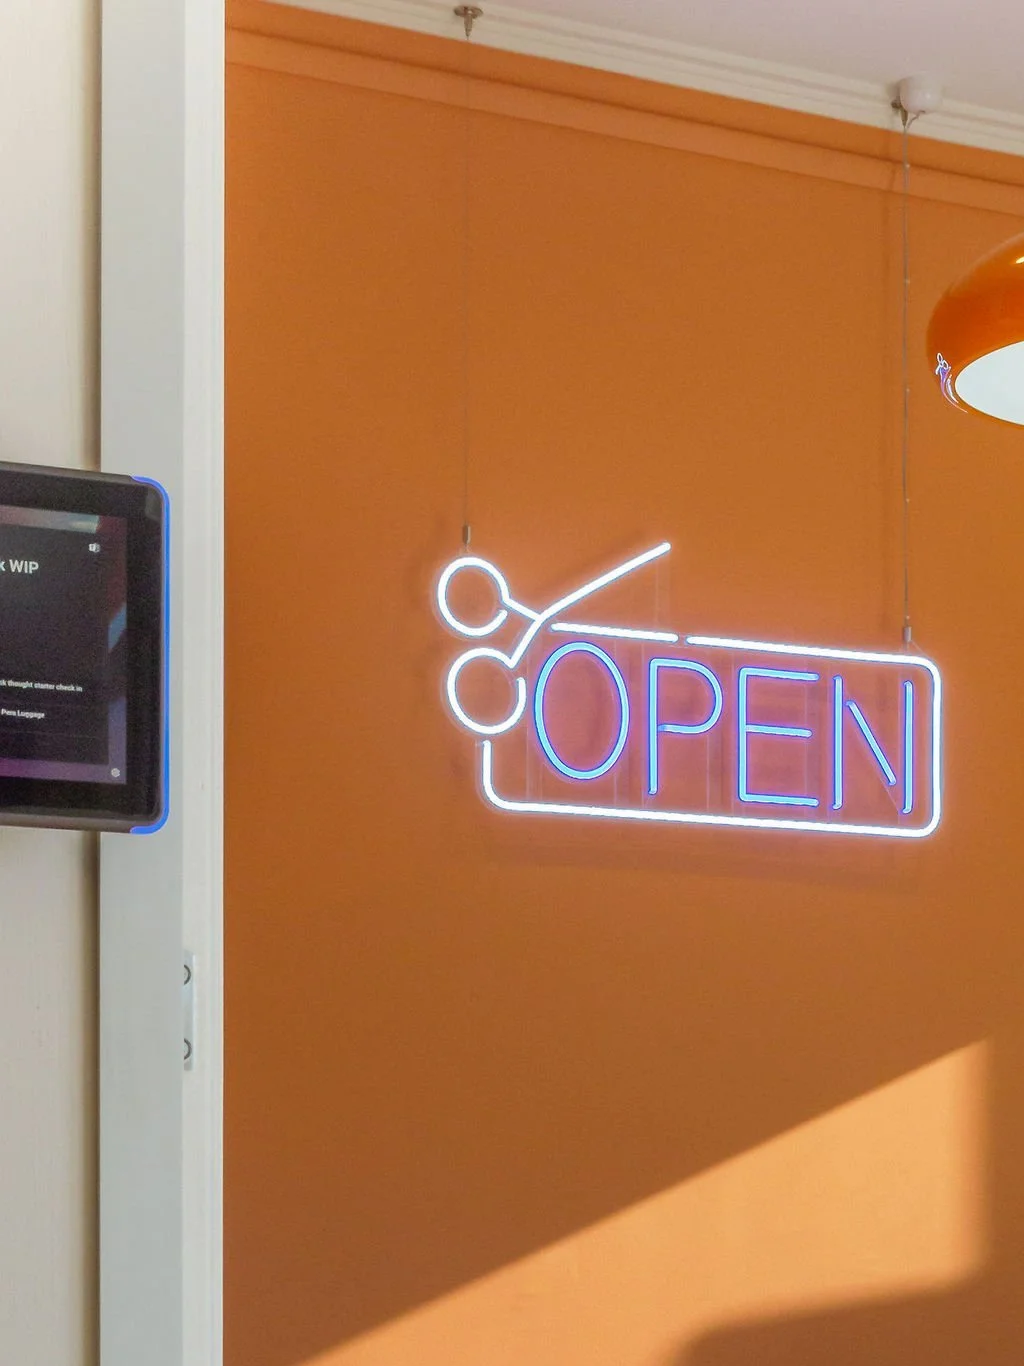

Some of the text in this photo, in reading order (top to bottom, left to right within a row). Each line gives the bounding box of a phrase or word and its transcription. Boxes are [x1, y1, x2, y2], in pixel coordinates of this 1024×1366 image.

[9, 559, 39, 574] WIP
[7, 680, 33, 689] thought
[34, 682, 55, 690] starter
[55, 684, 75, 692] check
[17, 709, 45, 719] Luggage
[534, 641, 913, 814] OPEN
